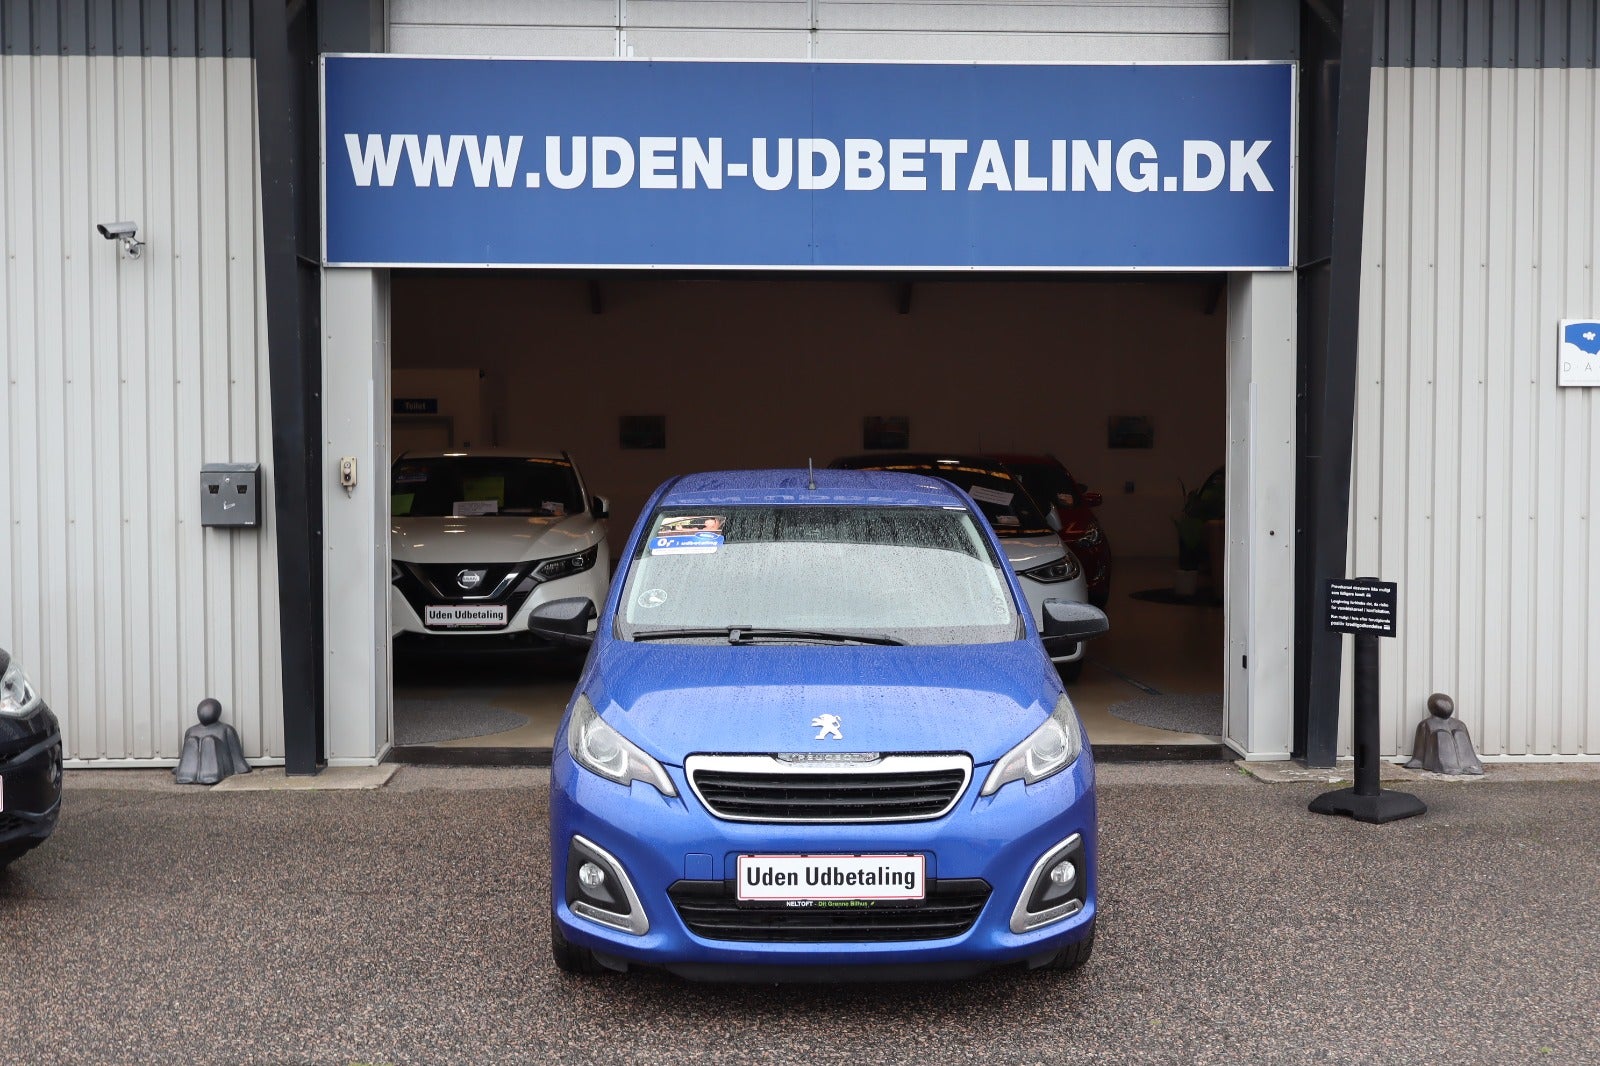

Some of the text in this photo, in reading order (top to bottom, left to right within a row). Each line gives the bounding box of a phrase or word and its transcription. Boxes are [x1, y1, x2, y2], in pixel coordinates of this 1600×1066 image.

[344, 133, 1274, 194] WWW.UDEN-UDBETALING.DK
[429, 610, 504, 620] Uden Udbetaling
[747, 867, 916, 890] Uden Udbetaling
